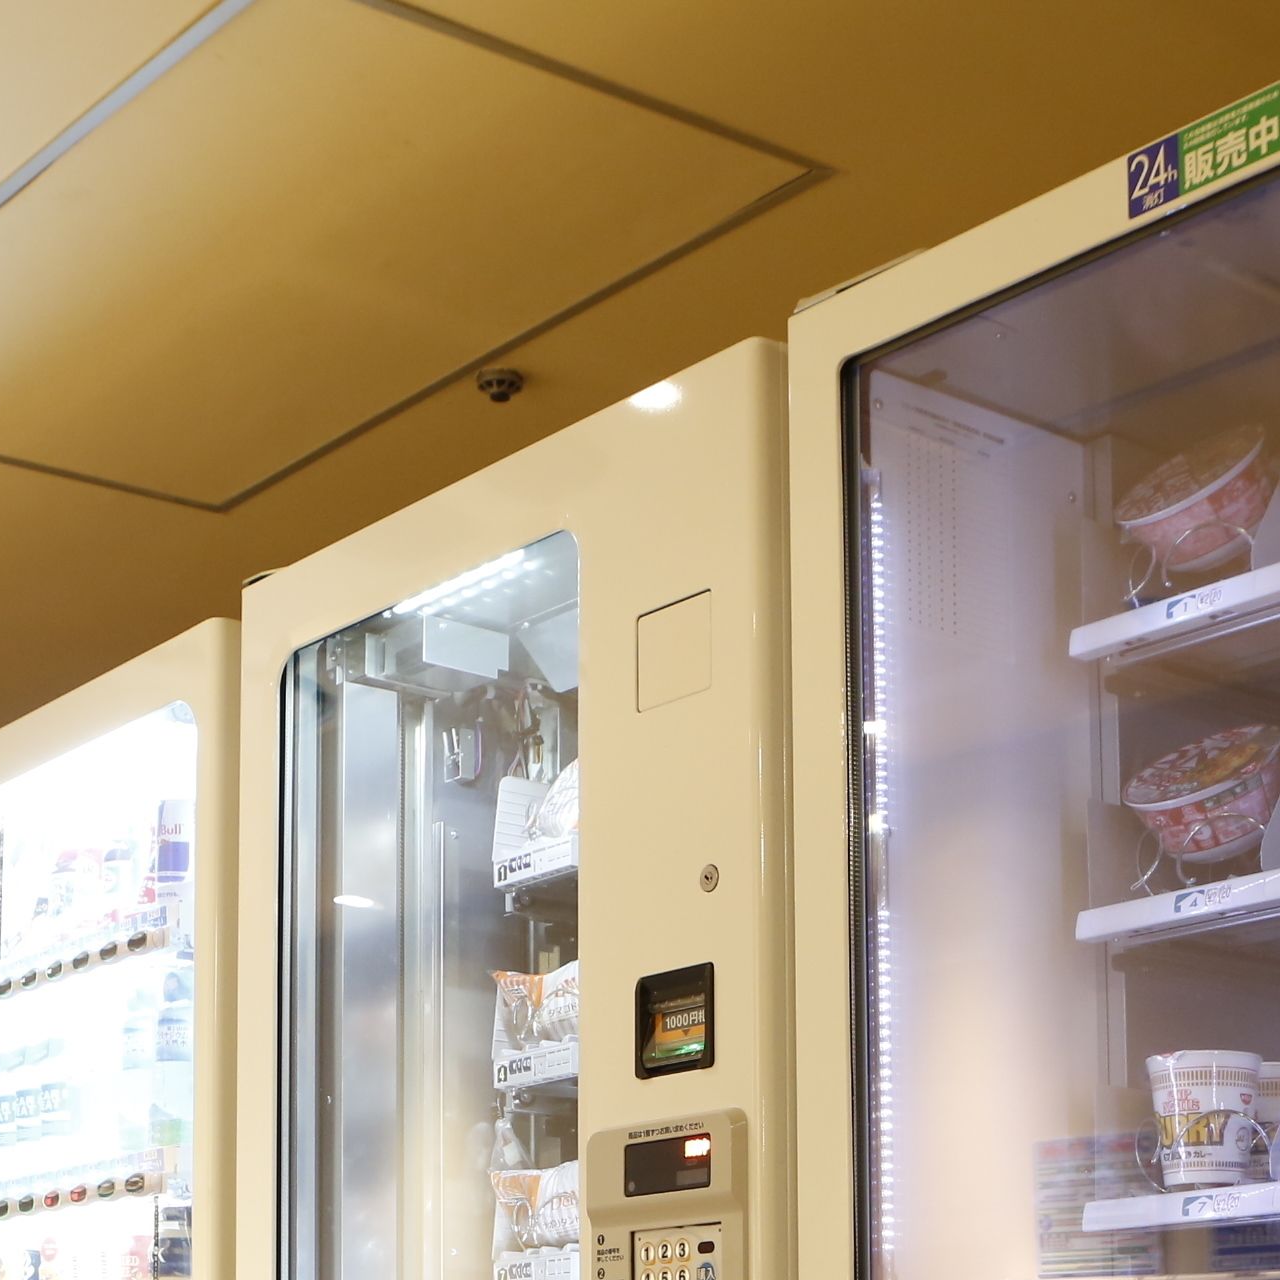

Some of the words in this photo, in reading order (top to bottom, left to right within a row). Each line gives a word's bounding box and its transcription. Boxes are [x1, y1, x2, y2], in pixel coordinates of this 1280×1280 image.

[1183, 115, 1280, 190] 販売中
[665, 1008, 705, 1030] 1000円札
[661, 1244, 668, 1259] 2
[678, 1243, 686, 1257] 3
